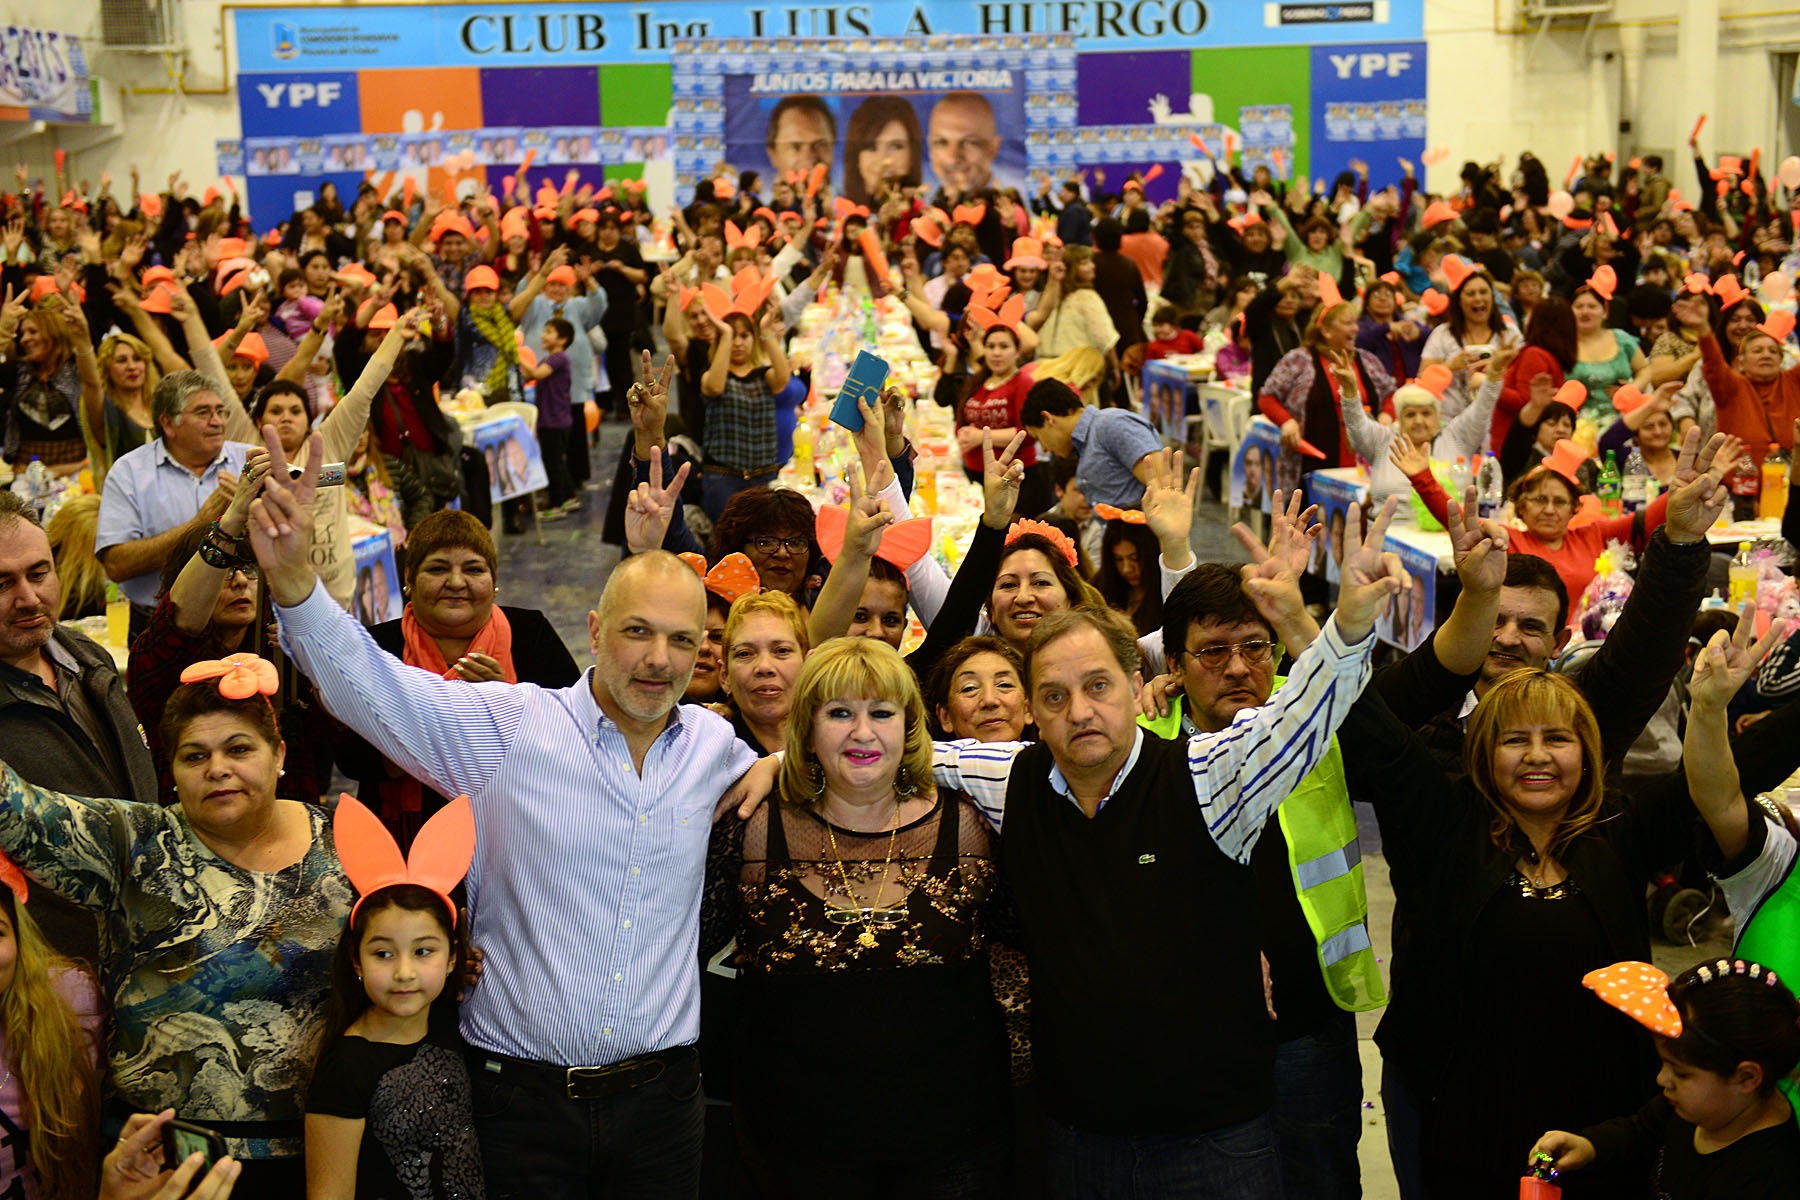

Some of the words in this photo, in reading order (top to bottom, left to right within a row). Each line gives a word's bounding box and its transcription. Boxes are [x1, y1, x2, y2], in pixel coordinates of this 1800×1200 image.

[461, 13, 605, 53] CLUB
[905, 5, 931, 36] A
[979, 0, 1208, 38] HUERGO
[1328, 51, 1412, 79] YPF
[749, 72, 829, 92] JUNTOS
[831, 71, 885, 90] PARA
[886, 71, 915, 89] LA
[917, 69, 1013, 88] VICTORIA
[257, 82, 341, 108] YPF
